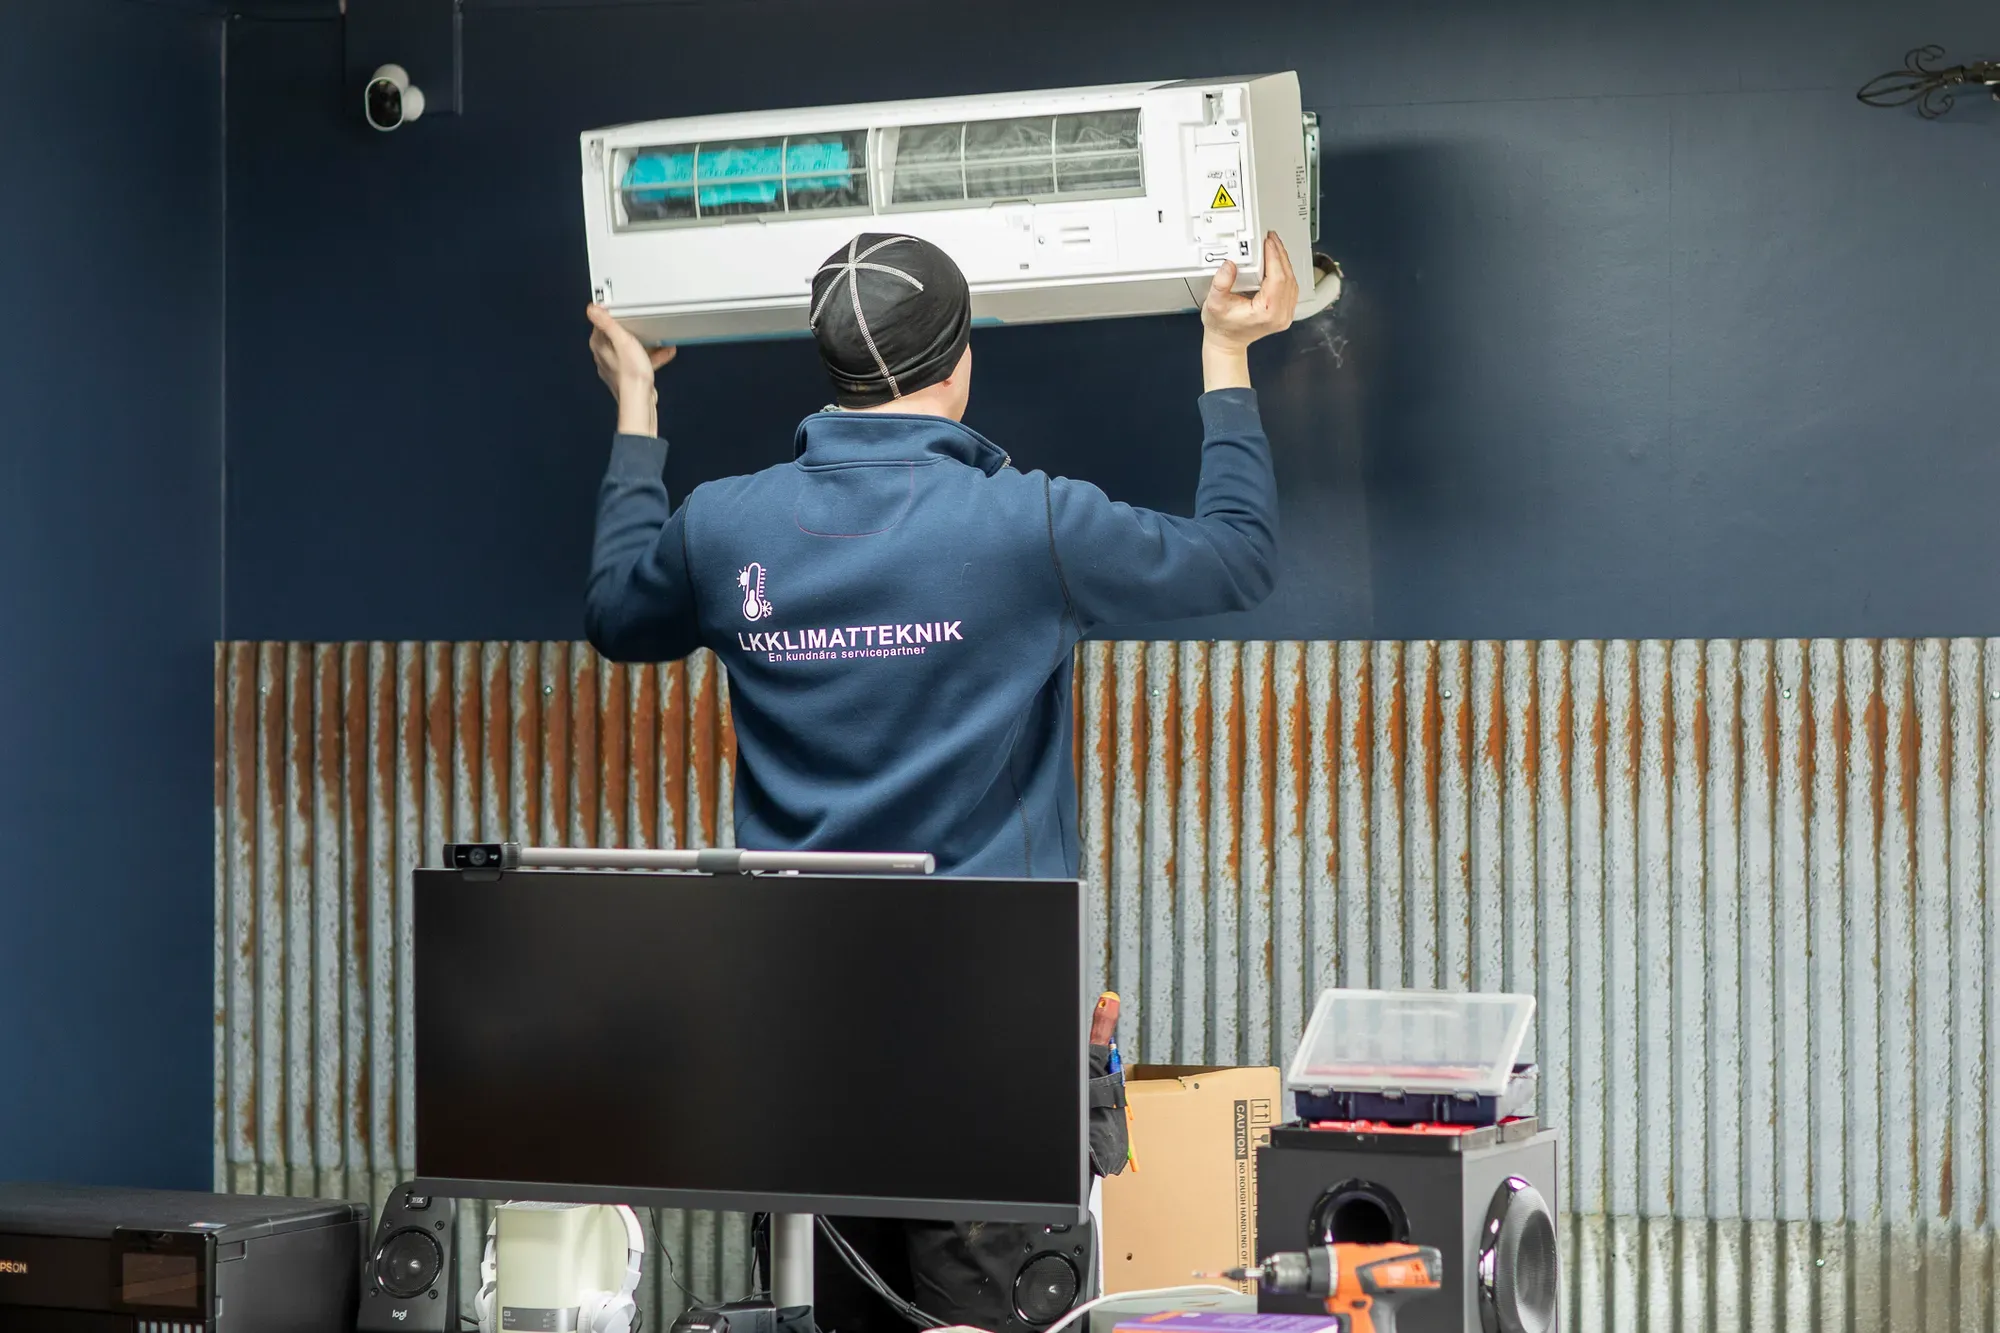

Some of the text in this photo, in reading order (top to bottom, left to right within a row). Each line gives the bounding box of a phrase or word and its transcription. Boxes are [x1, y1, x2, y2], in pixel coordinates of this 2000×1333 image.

[768, 652, 782, 662] En
[841, 646, 926, 658] servicepartner
[1236, 1104, 1246, 1156] CAUTION
[1239, 1162, 1246, 1174] NO
[1239, 1176, 1247, 1205] ROUGH
[1240, 1207, 1248, 1249] HANDLING
[1241, 1250, 1248, 1261] OF
[0, 1261, 28, 1274] PSON
[392, 1309, 408, 1321] logi
